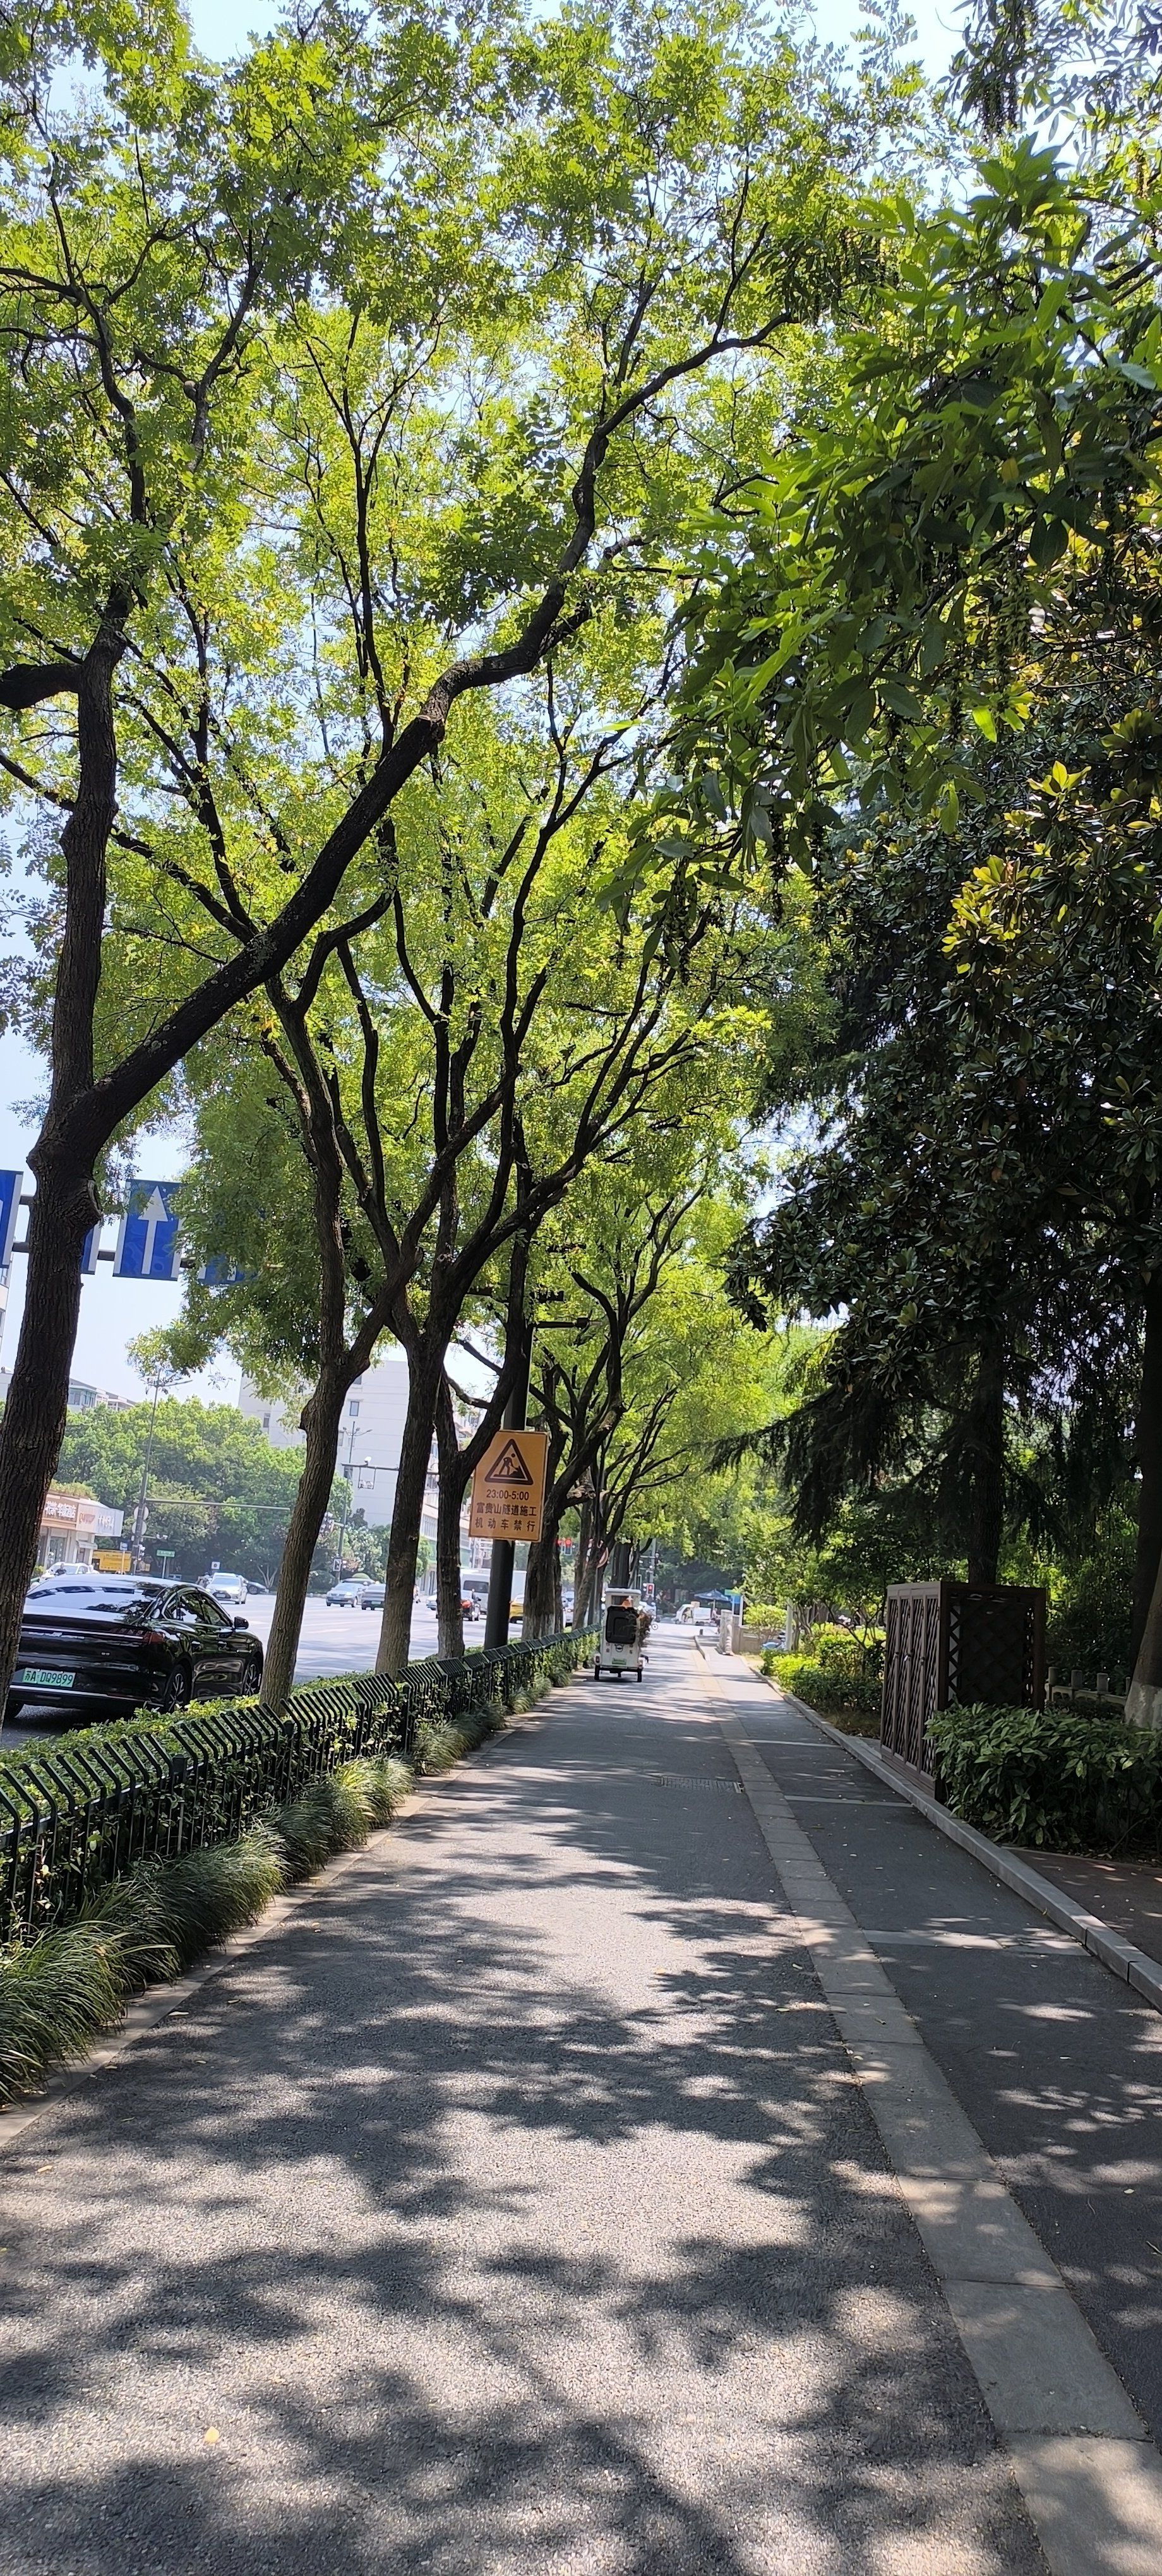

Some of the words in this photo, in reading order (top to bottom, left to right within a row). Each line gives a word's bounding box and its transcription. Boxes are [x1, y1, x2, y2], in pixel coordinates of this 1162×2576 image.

[486, 1489, 529, 1501] 23:00-5:00
[476, 1502, 537, 1516] 富贵山隧道施工
[475, 1517, 536, 1532] 机动车禁行
